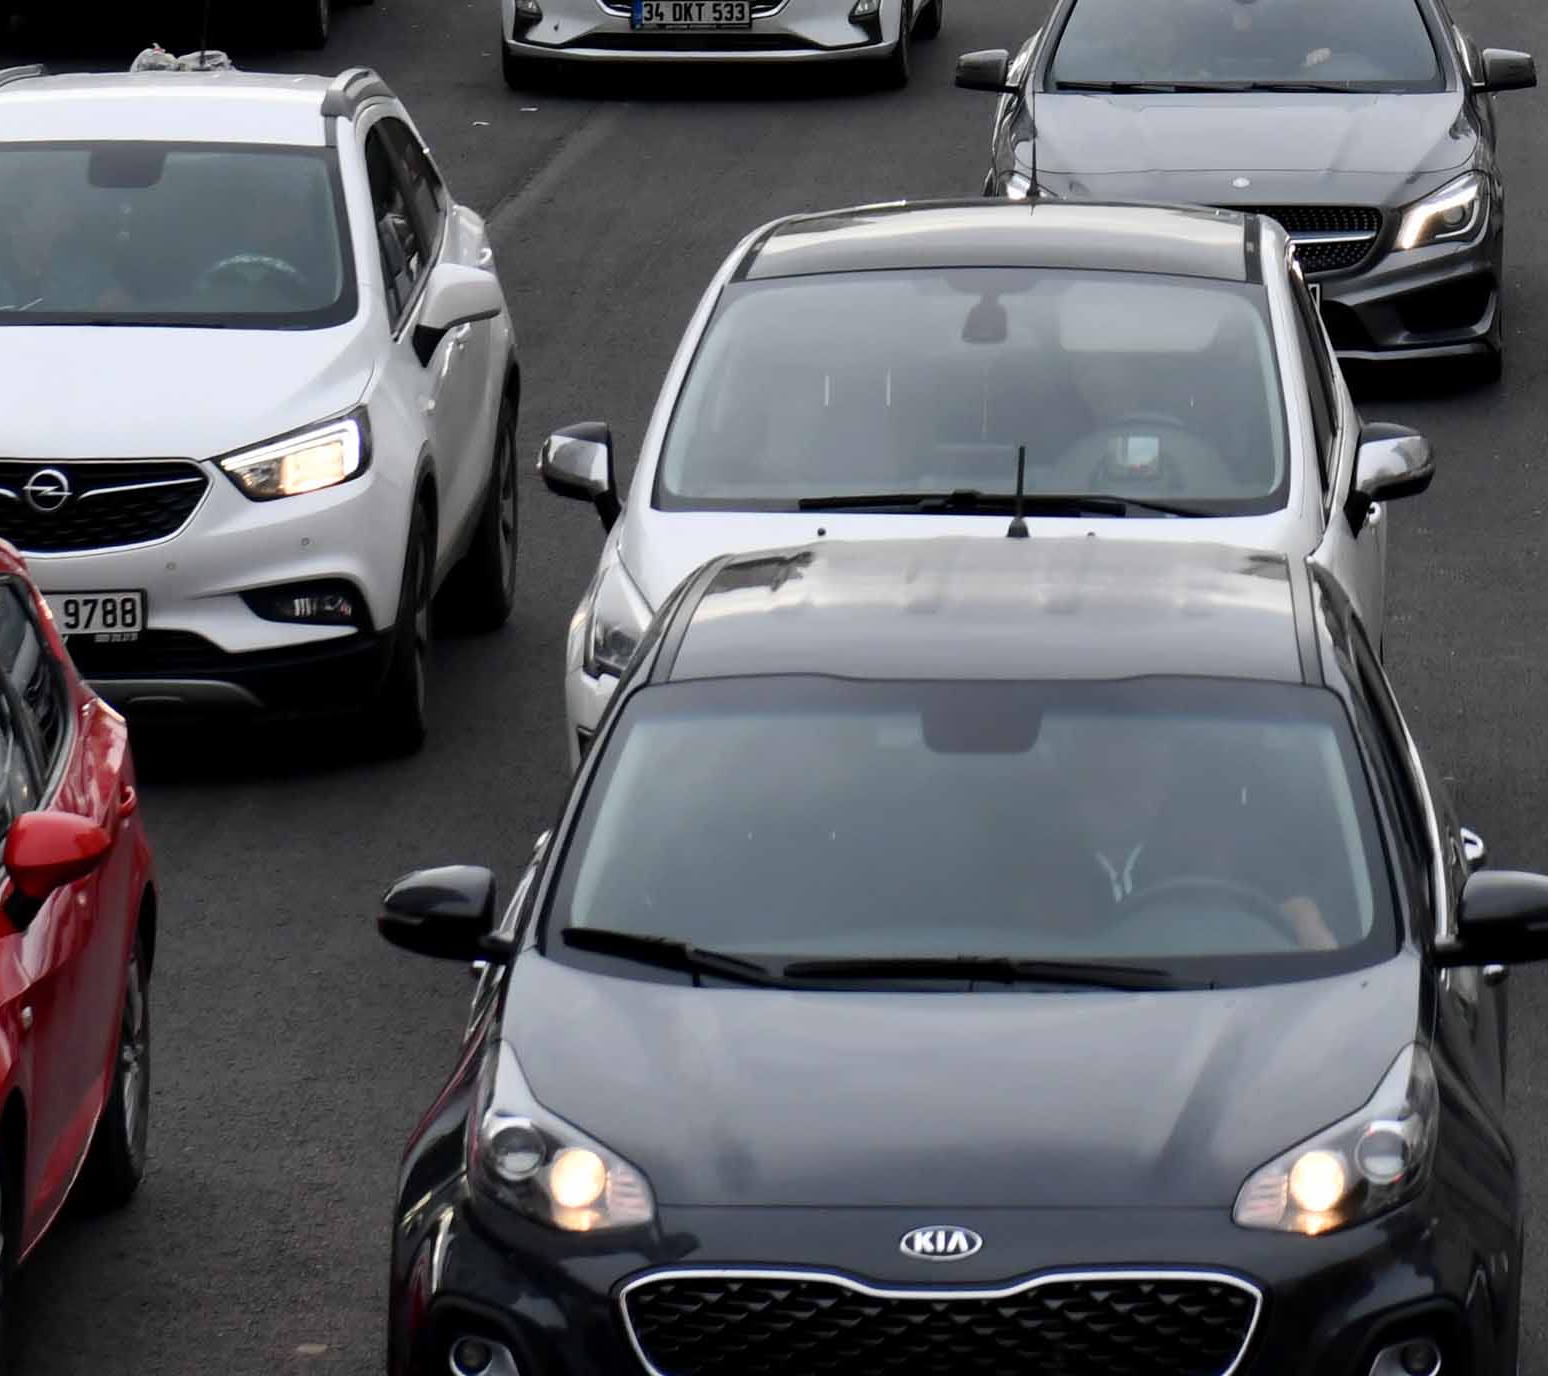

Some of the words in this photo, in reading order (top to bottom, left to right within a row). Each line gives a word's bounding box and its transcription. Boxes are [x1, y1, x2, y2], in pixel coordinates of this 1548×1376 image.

[643, 3, 664, 21] 34
[672, 3, 704, 22] DKT
[712, 3, 746, 21] 533
[63, 598, 137, 630] 9788
[913, 1230, 970, 1254] KIA
